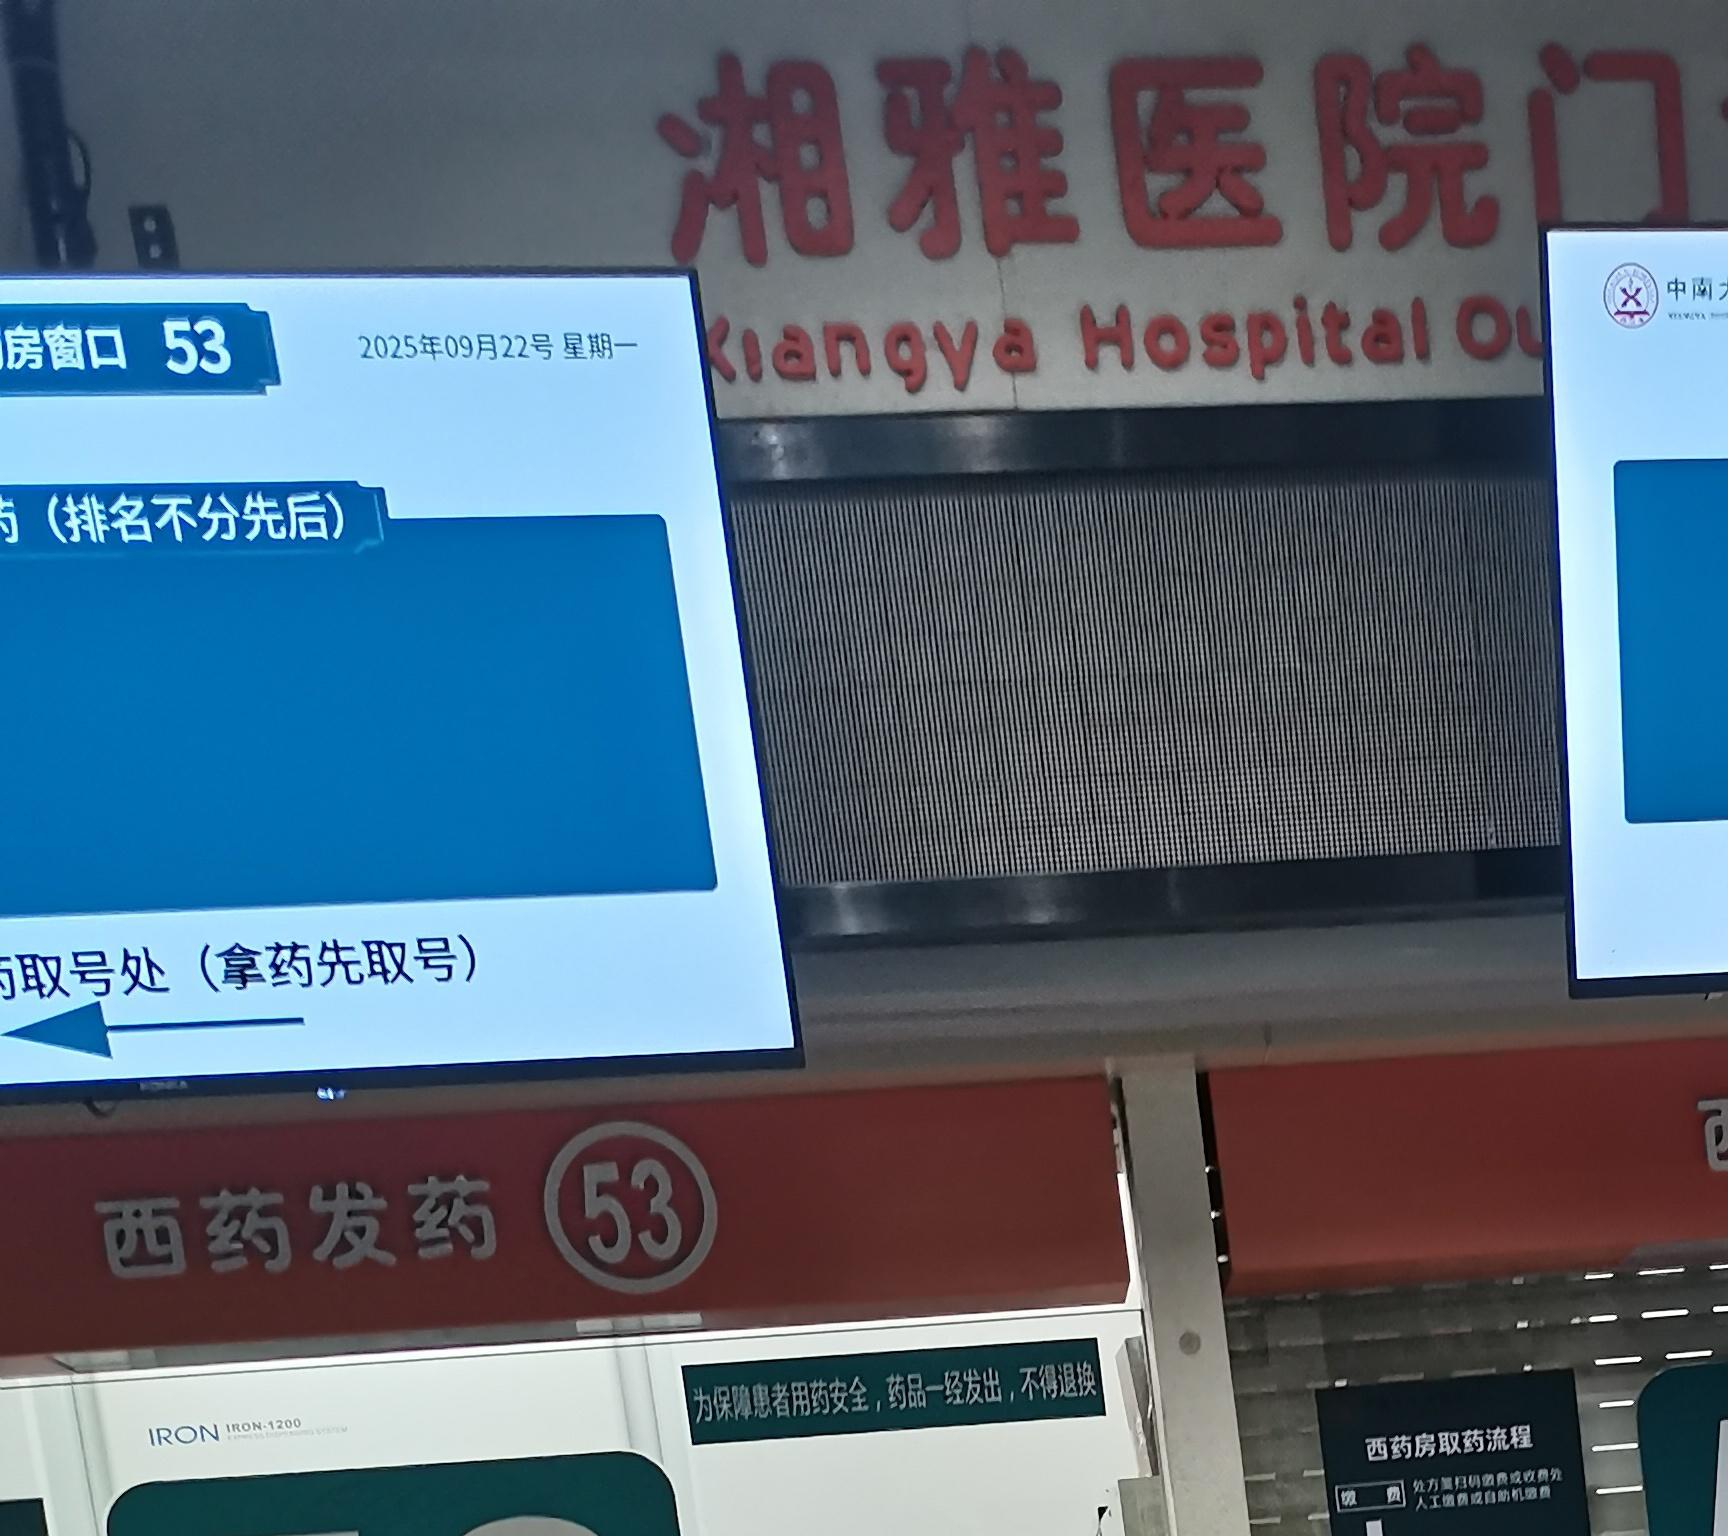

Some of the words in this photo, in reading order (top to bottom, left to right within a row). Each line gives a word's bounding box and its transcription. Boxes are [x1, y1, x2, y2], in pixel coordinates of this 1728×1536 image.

[0, 320, 127, 370] 房窗口
[162, 316, 231, 374] 53
[358, 332, 555, 362] 2025年09月22号
[563, 332, 639, 362] 星期一
[1078, 294, 1430, 383] Hospital
[94, 1177, 498, 1280] 西药发药
[582, 1158, 684, 1265] 53
[694, 1359, 1097, 1424] 为保障患者用药安全，药品一经发出，不得退换
[149, 1424, 220, 1446] IRON
[226, 1418, 301, 1434] IRON-1200
[1365, 1425, 1534, 1462] 西药房取药流程
